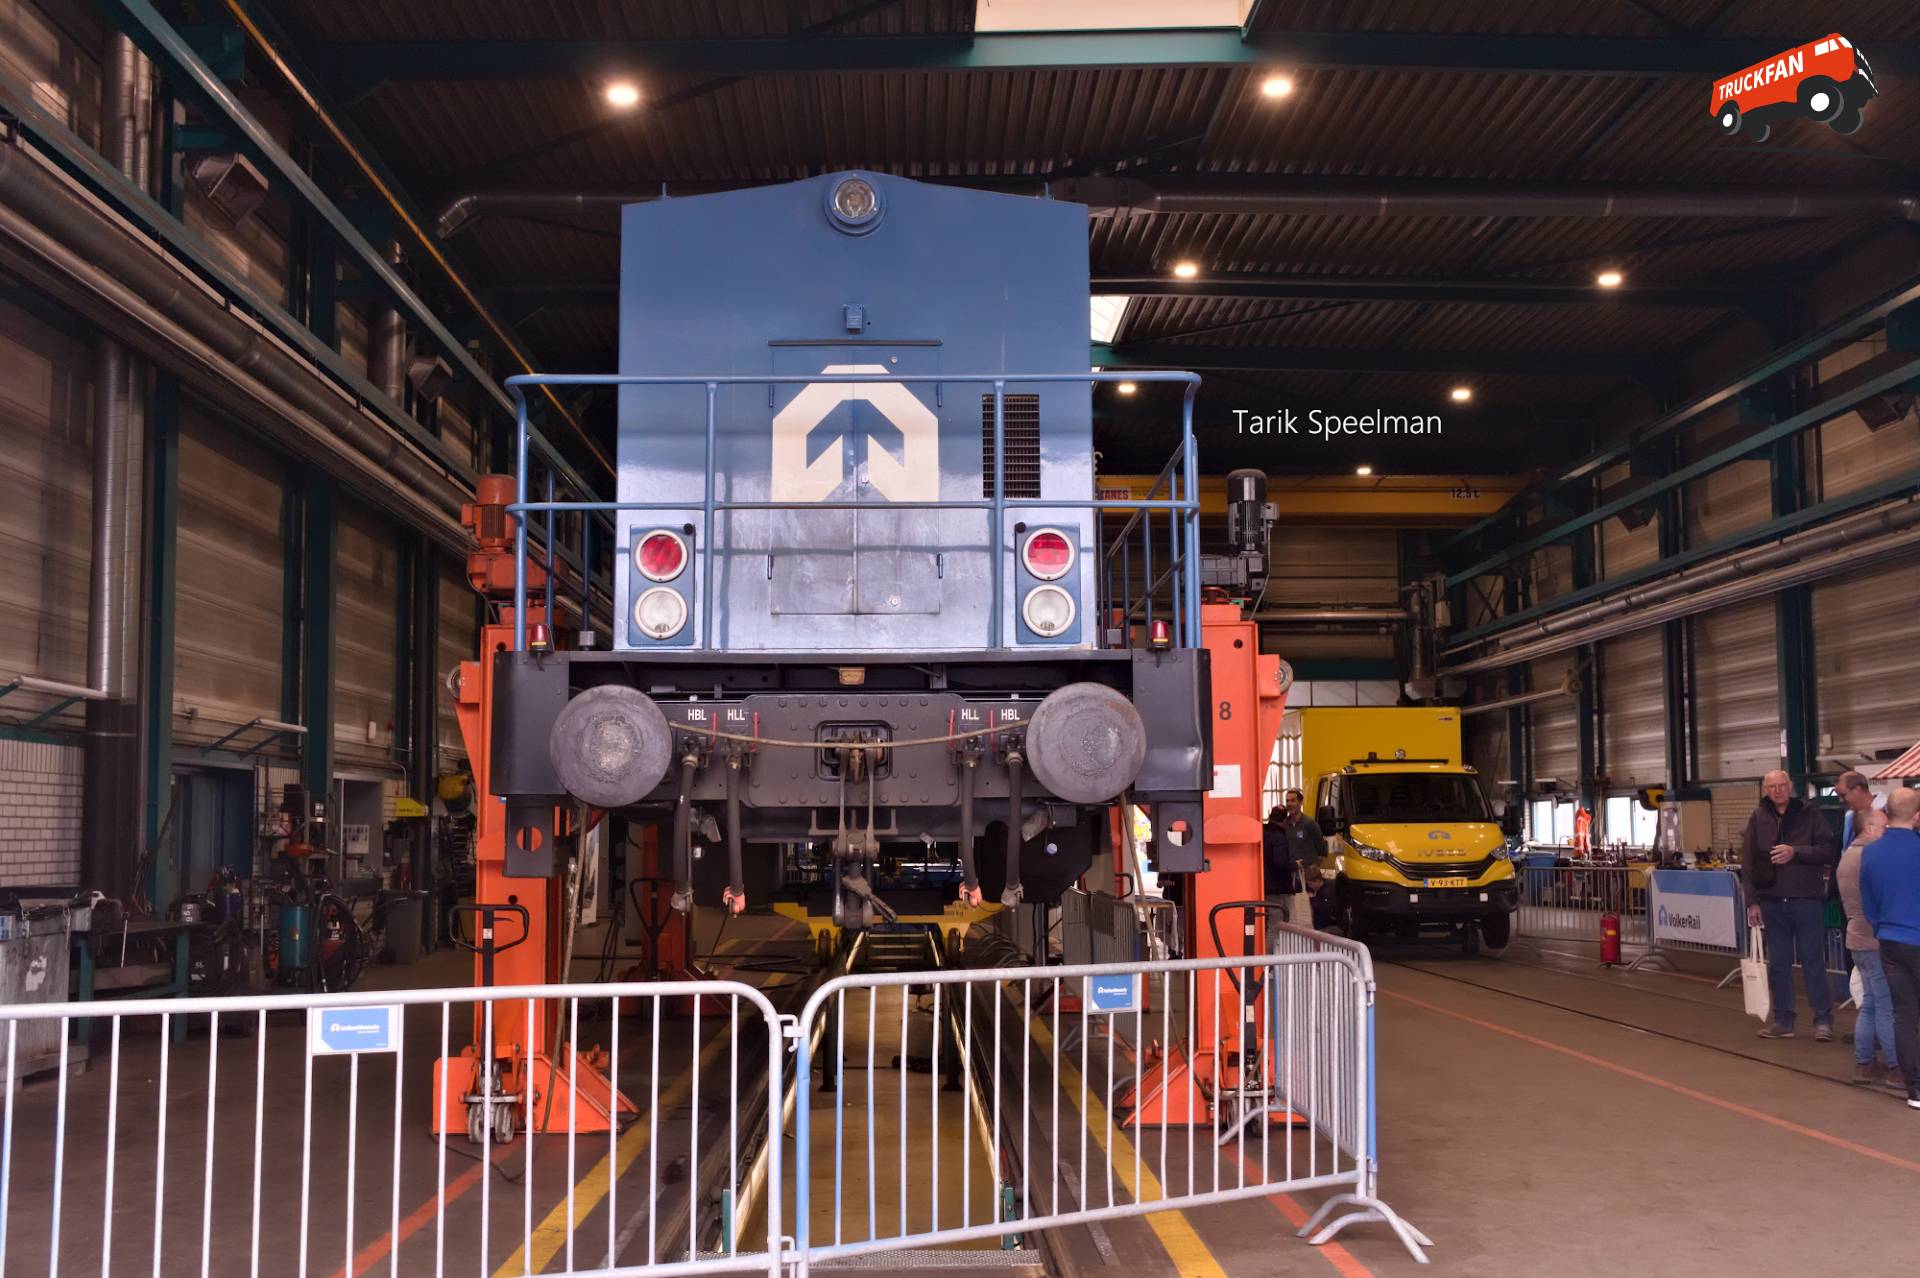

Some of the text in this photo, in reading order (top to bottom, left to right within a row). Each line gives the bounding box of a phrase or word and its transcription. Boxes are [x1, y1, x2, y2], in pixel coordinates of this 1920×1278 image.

[687, 708, 707, 721] HBL
[727, 708, 746, 721] HLL
[961, 708, 980, 720] HLL
[1001, 708, 1020, 721] HBL
[1219, 701, 1232, 721] 8
[1669, 912, 1701, 930] VolkerRail
